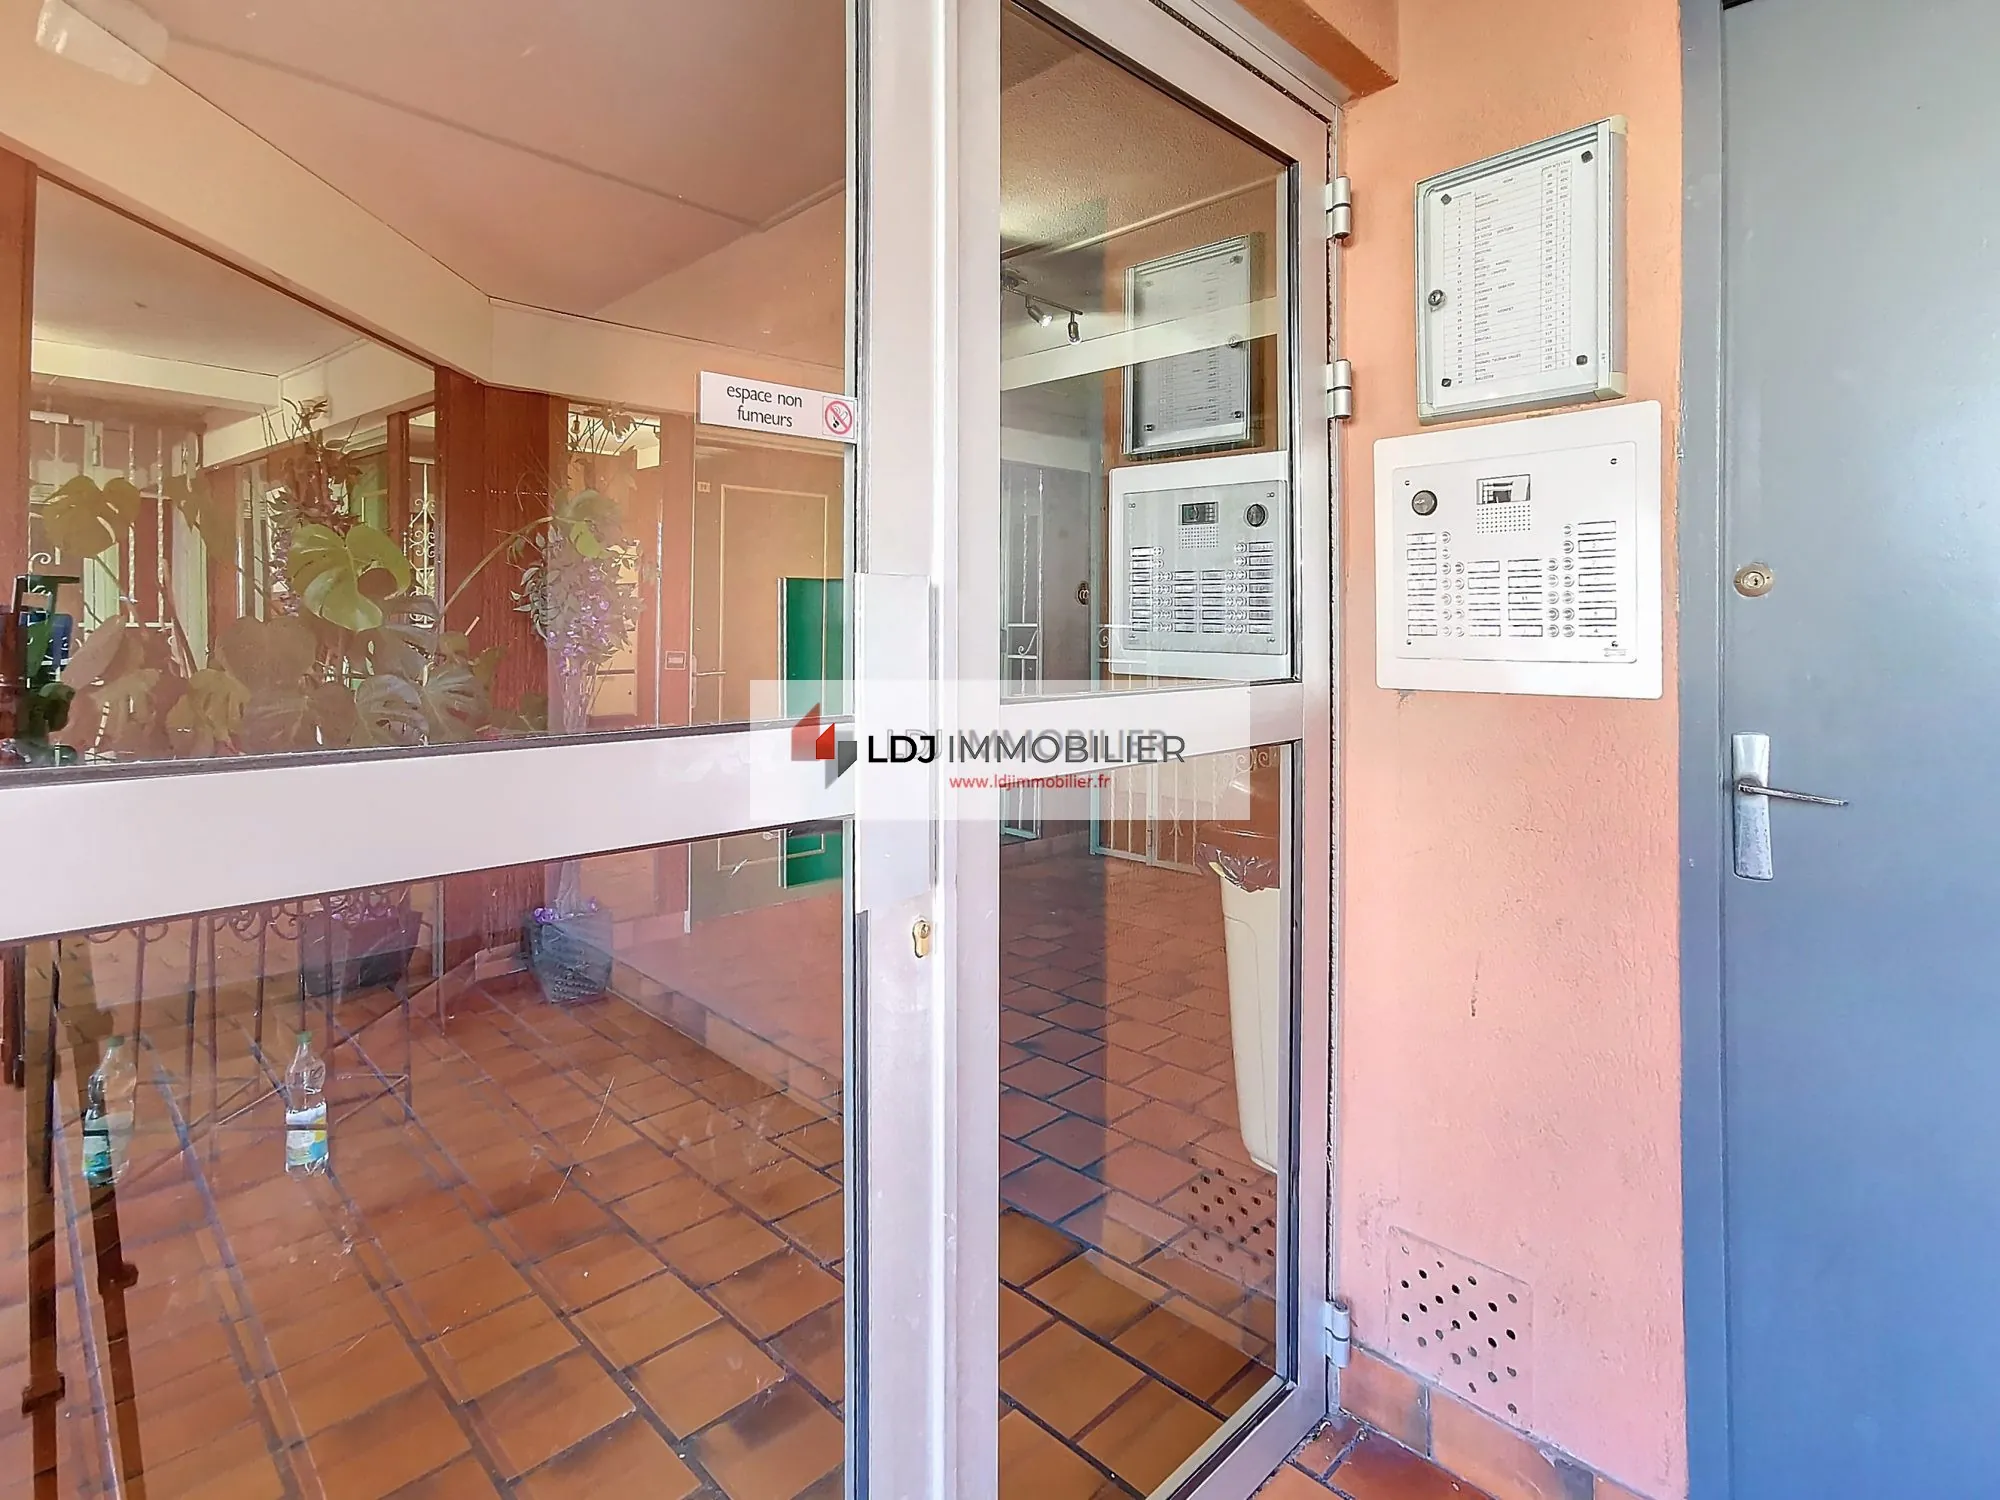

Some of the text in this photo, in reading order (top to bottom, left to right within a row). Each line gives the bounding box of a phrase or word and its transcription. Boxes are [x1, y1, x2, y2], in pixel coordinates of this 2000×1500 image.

[726, 386, 803, 408] espace non
[737, 404, 793, 428] fumeurs
